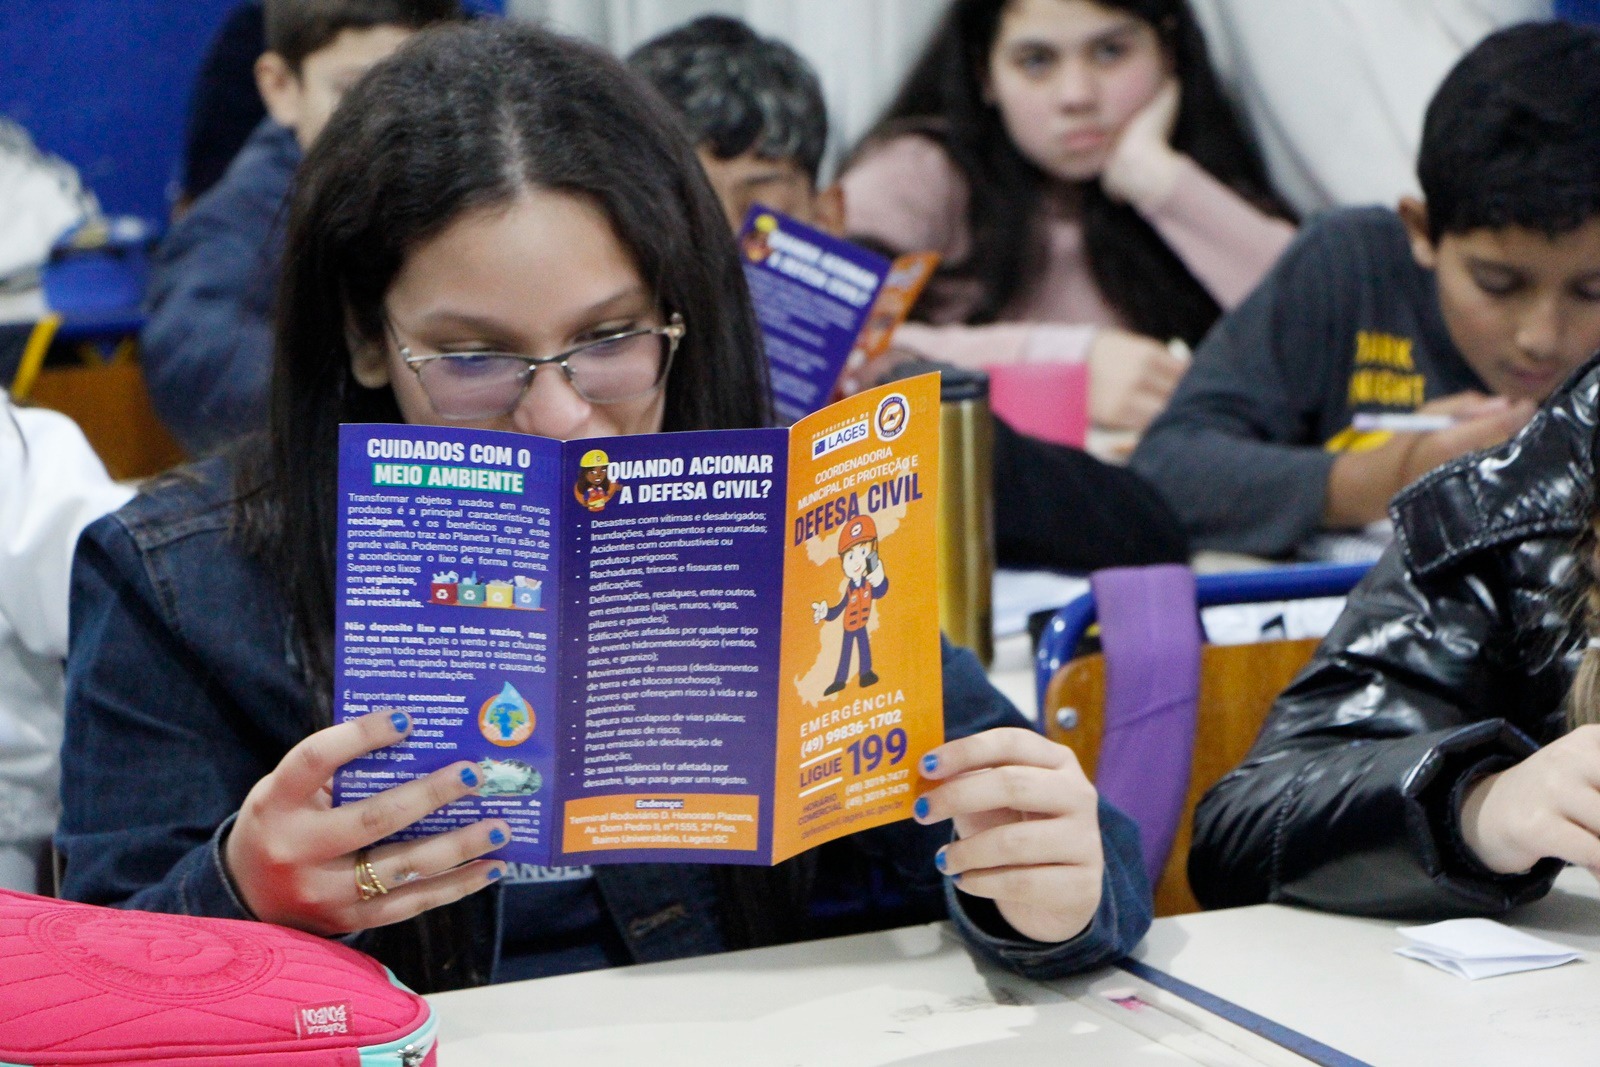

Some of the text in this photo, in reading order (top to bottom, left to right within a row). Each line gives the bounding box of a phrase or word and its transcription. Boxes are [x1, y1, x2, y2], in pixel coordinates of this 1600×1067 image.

[812, 417, 856, 439] PREFEITURA
[828, 424, 866, 449] LAGES
[367, 438, 530, 468] CUIDADOS COM O
[607, 455, 773, 482] QUANDO ACIONAR
[815, 447, 893, 484] COORDENADORIA
[374, 464, 524, 492] MEIO AMBIENTE
[798, 455, 918, 510] MUNICIPAL DE PROTEÇÃO E
[619, 480, 772, 504] A DEFESA CIVIL?
[348, 493, 550, 515] Transformar objetos usados em novos
[795, 473, 922, 547] DEFESA CIVIL
[348, 505, 392, 516] produtos
[397, 506, 404, 515] é
[421, 508, 463, 518] principal
[467, 510, 533, 524] característica
[538, 516, 550, 526] da
[591, 517, 636, 528] Desastres
[638, 516, 658, 525] com
[660, 513, 693, 523] vítimas
[702, 512, 766, 521] desabrigados;
[348, 517, 405, 528] reciclagem,
[447, 519, 497, 531] benefícios
[504, 525, 522, 535] que
[529, 528, 550, 538] este
[591, 530, 645, 542] Inundações,
[646, 526, 705, 537] alagamentos
[715, 525, 767, 534] enxurradas;
[347, 529, 415, 539] procedimento
[418, 531, 436, 540] traz
[453, 532, 489, 543] Planeta
[492, 535, 516, 545] Terra
[518, 537, 535, 547] são
[537, 539, 550, 549] de
[590, 542, 635, 554] Acidentes
[637, 541, 657, 549] com
[658, 538, 719, 548] combustíveis
[347, 540, 549, 560] grande valia. Podemos pensar em separar
[347, 563, 421, 574] Separe os lixos
[359, 552, 421, 562] acondicionar
[439, 554, 456, 563] lixo
[461, 555, 474, 564] de
[478, 556, 507, 566] forma
[512, 560, 549, 571] correta.
[590, 553, 678, 568] produtos perigosos;
[589, 567, 644, 579] Rachaduras,
[646, 565, 677, 574] trincas
[687, 563, 722, 572] fissuras
[724, 563, 739, 571] em
[365, 575, 417, 586] orgânicos,
[589, 580, 643, 592] edificações;
[346, 587, 401, 596] recicláveis
[589, 588, 756, 604] Deformações, recalques, entre outros,
[346, 598, 424, 608] não recicláveis.
[588, 609, 603, 617] em
[605, 605, 650, 615] estruturas
[679, 602, 711, 610] muros,
[712, 601, 738, 610] vigas,
[345, 622, 365, 631] Não
[370, 623, 413, 633] deposite
[417, 624, 435, 633] lixo
[460, 625, 485, 635] lotes
[490, 627, 524, 638] vazios,
[528, 631, 547, 640] nos
[588, 620, 618, 631] pilares
[627, 615, 669, 627] paredes);
[588, 626, 758, 642] Edificações afetadas por qualquer tipo
[587, 639, 757, 654] de evento hidrometeorológico (ventos,
[344, 669, 407, 679] alagamentos
[417, 670, 476, 681] inundações.
[587, 668, 642, 679] Movimentos
[643, 665, 655, 673] de
[689, 663, 758, 673] (deslizamentos
[344, 691, 466, 702] É importante economizar
[586, 704, 635, 717] patrimônio;
[801, 689, 905, 737] EMERGÊNCIA
[586, 717, 619, 728] Ruptura
[634, 713, 668, 724] colapso
[670, 713, 684, 722] de
[685, 713, 703, 722] vias
[705, 713, 745, 723] públicas;
[801, 710, 902, 758] (49) 99836-1702
[847, 728, 907, 776] 199
[800, 757, 842, 787] LIGUE
[636, 800, 683, 809] Endereço:
[301, 1004, 347, 1025] BONBON
